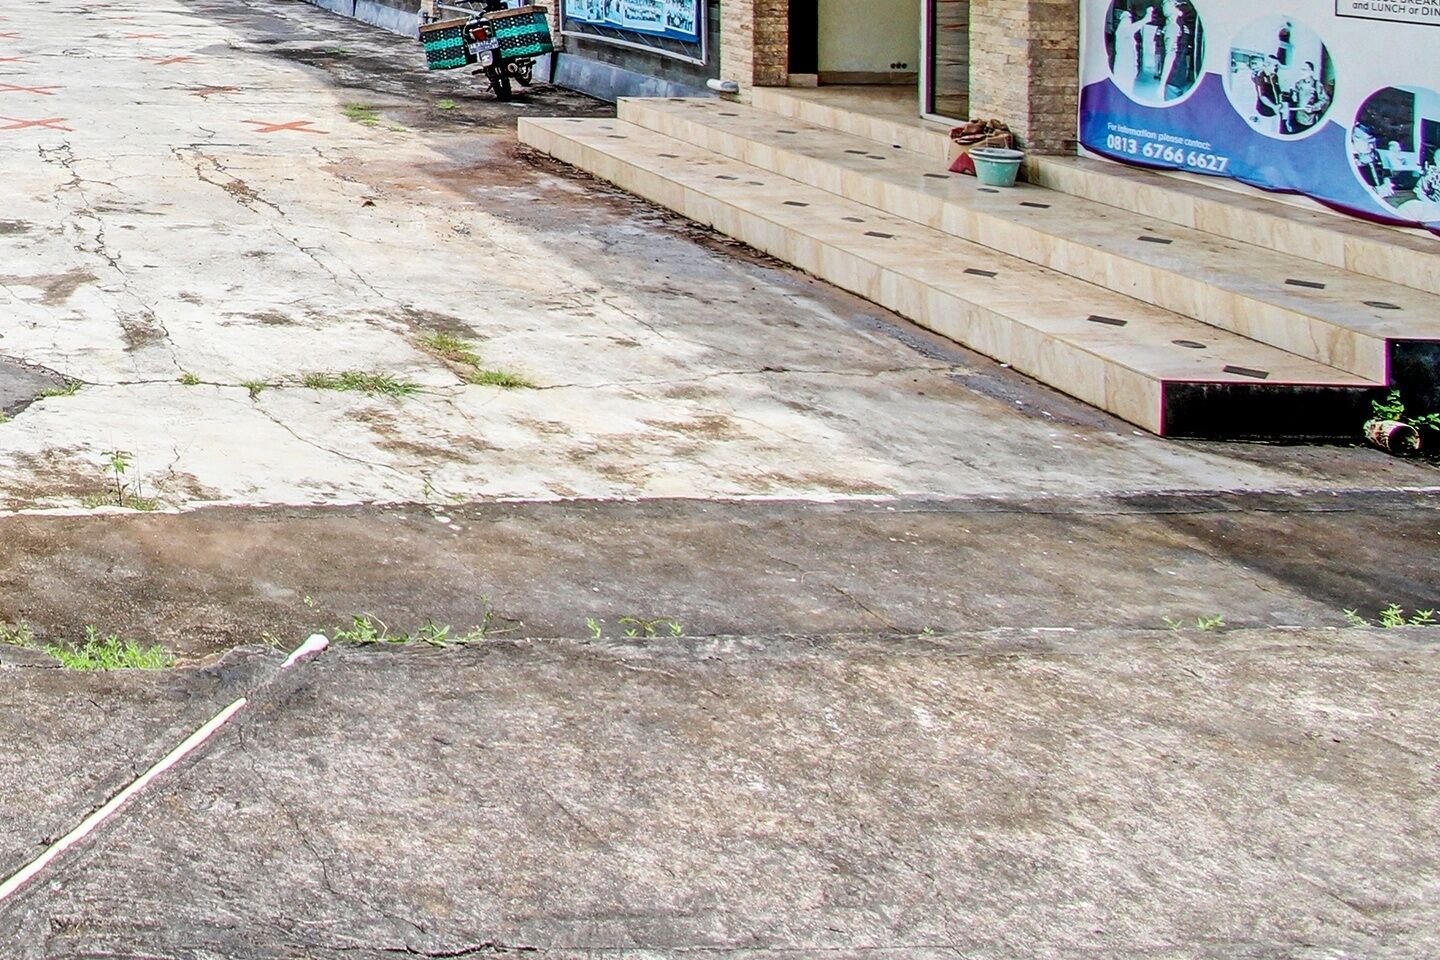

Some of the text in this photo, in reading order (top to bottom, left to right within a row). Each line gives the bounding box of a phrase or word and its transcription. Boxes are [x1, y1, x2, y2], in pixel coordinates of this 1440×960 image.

[1352, 2, 1369, 10] and
[1371, 3, 1406, 14] LUNCH
[1408, 7, 1419, 15] or
[1158, 132, 1184, 145] please
[1106, 134, 1229, 172] 0813 6766 6627
